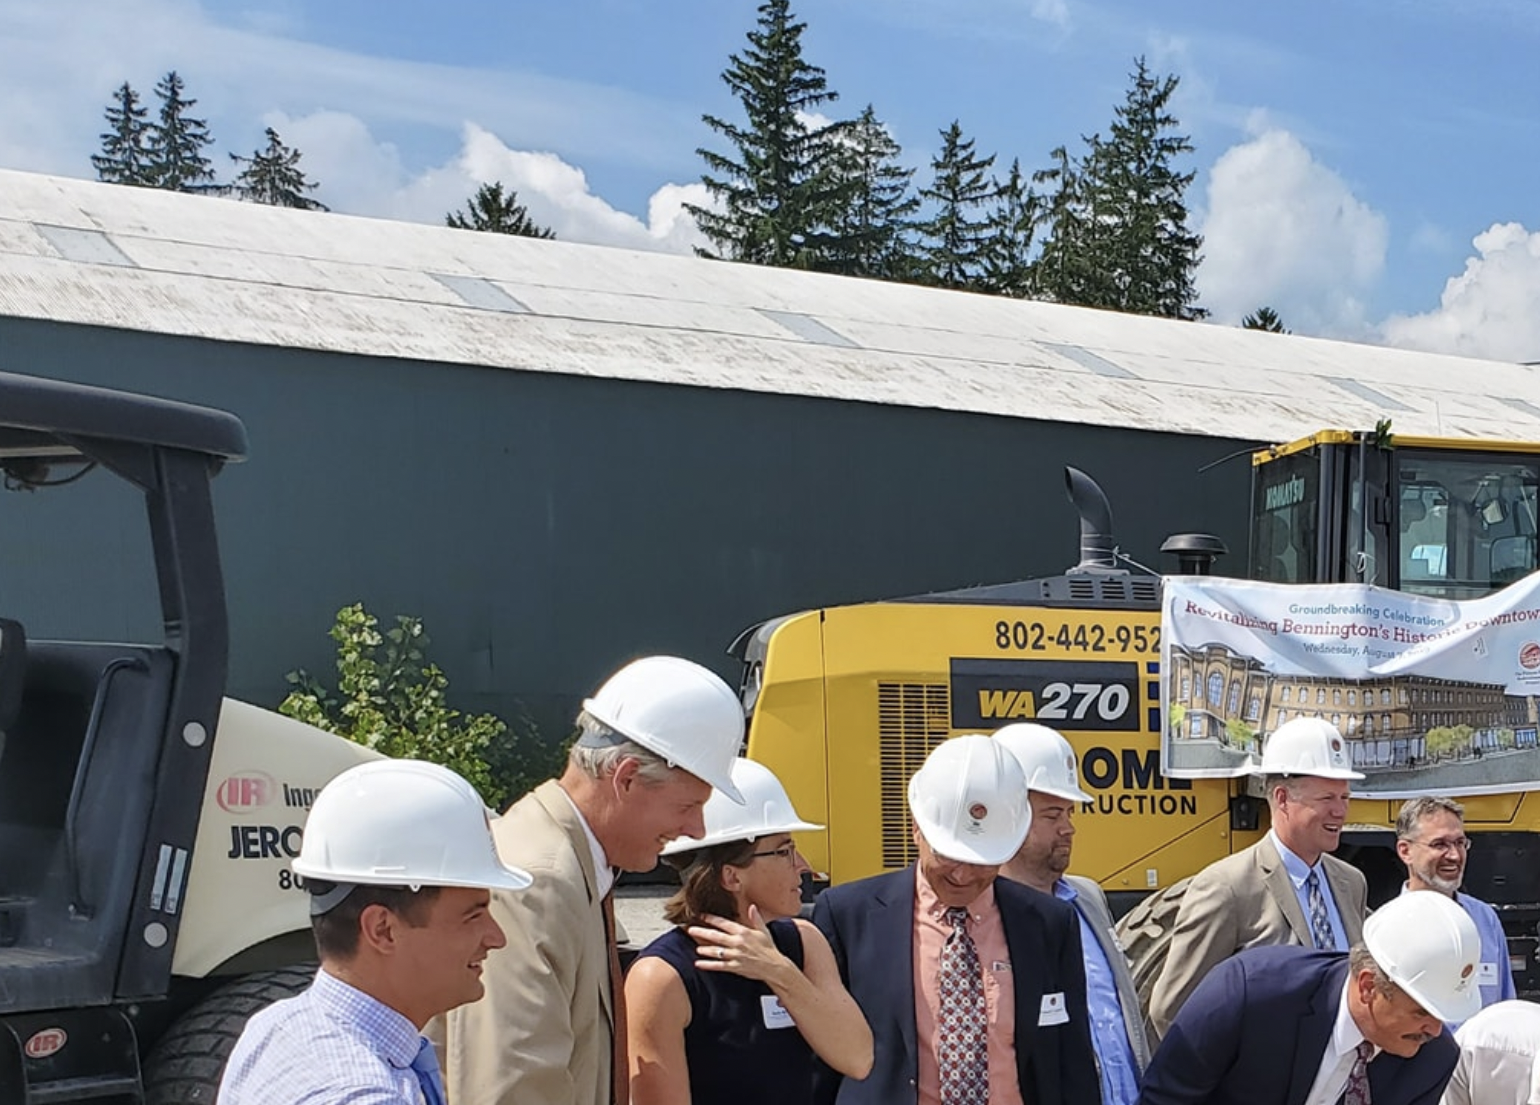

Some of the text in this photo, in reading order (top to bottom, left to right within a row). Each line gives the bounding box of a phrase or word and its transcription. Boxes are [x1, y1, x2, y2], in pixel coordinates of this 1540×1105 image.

[1289, 603, 1446, 627] Groundbreaking Celebration
[1282, 618, 1390, 641] Bennington's
[1393, 625, 1461, 644] Historic
[1303, 642, 1360, 657] Wednesday,
[979, 682, 1130, 721] WA270
